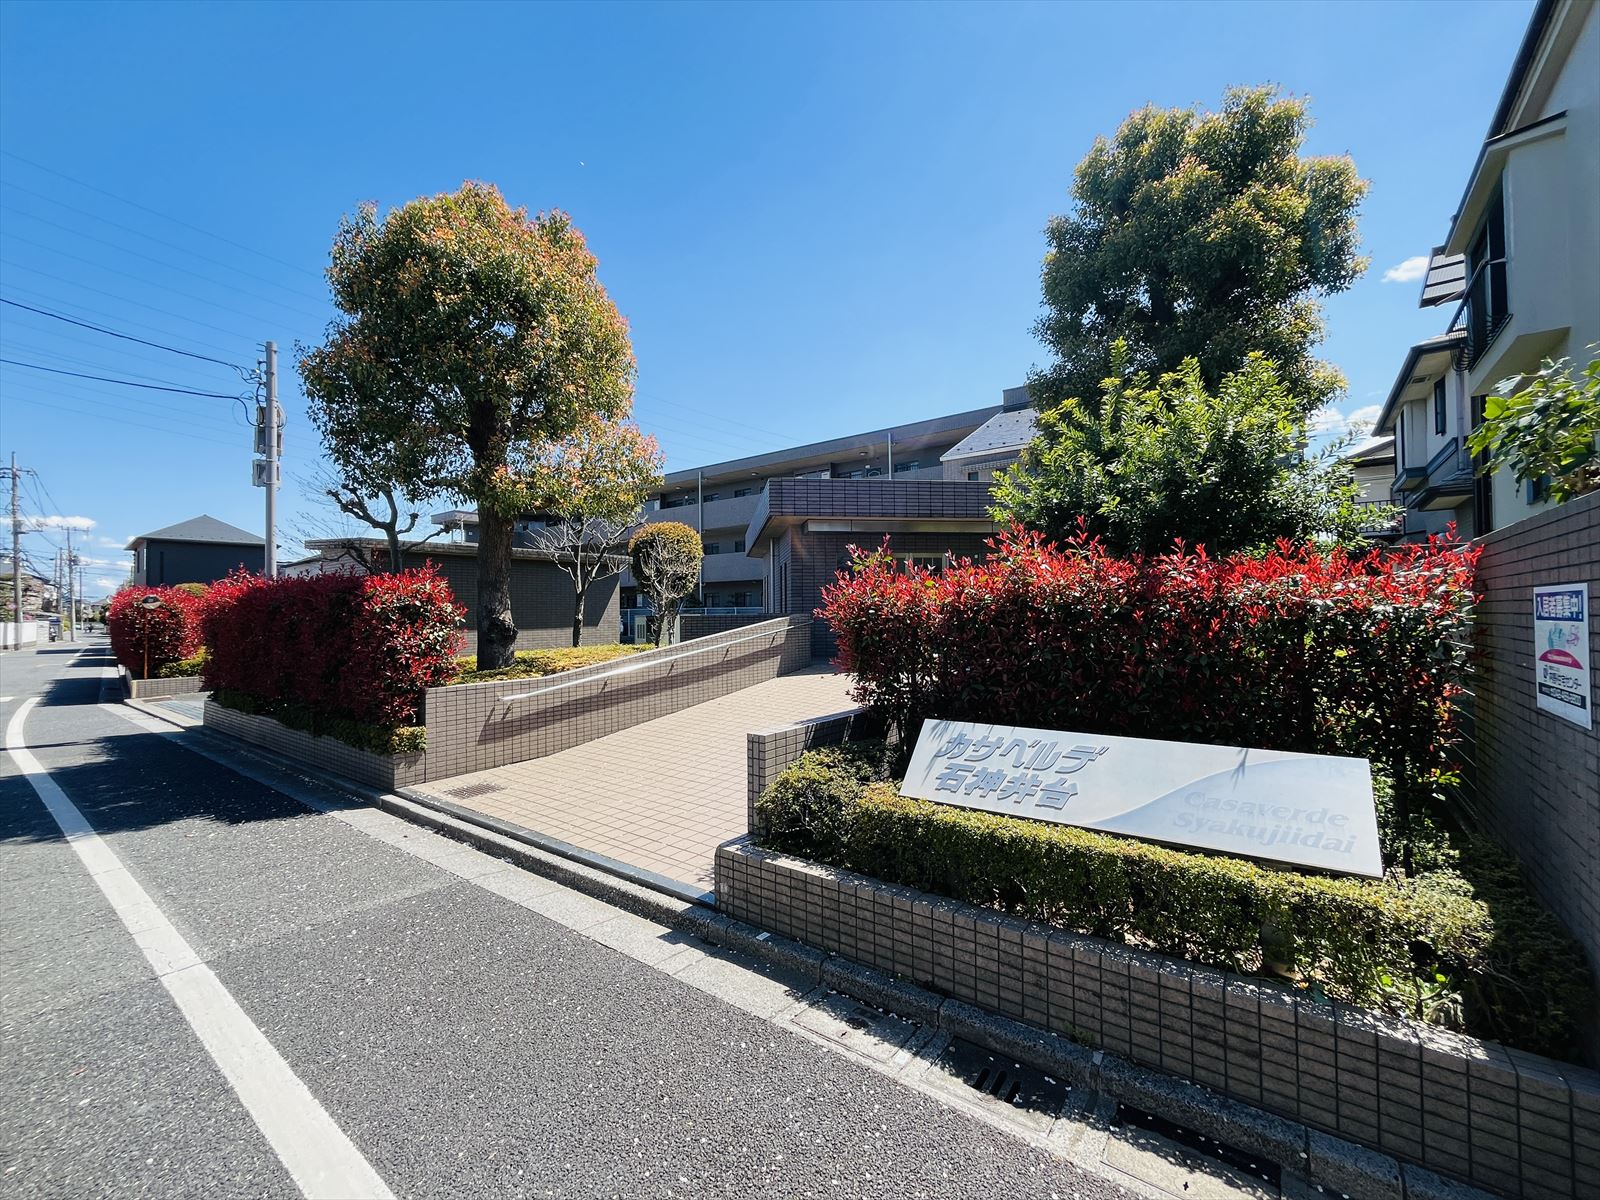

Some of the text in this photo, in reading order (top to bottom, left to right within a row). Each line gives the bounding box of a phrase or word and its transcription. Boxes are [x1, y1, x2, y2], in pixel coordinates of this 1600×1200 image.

[935, 731, 1109, 774] カサベルデ
[935, 762, 1079, 810] 石神井台
[1184, 791, 1350, 827] Casaverde
[1173, 812, 1357, 853] Syakujiidai
